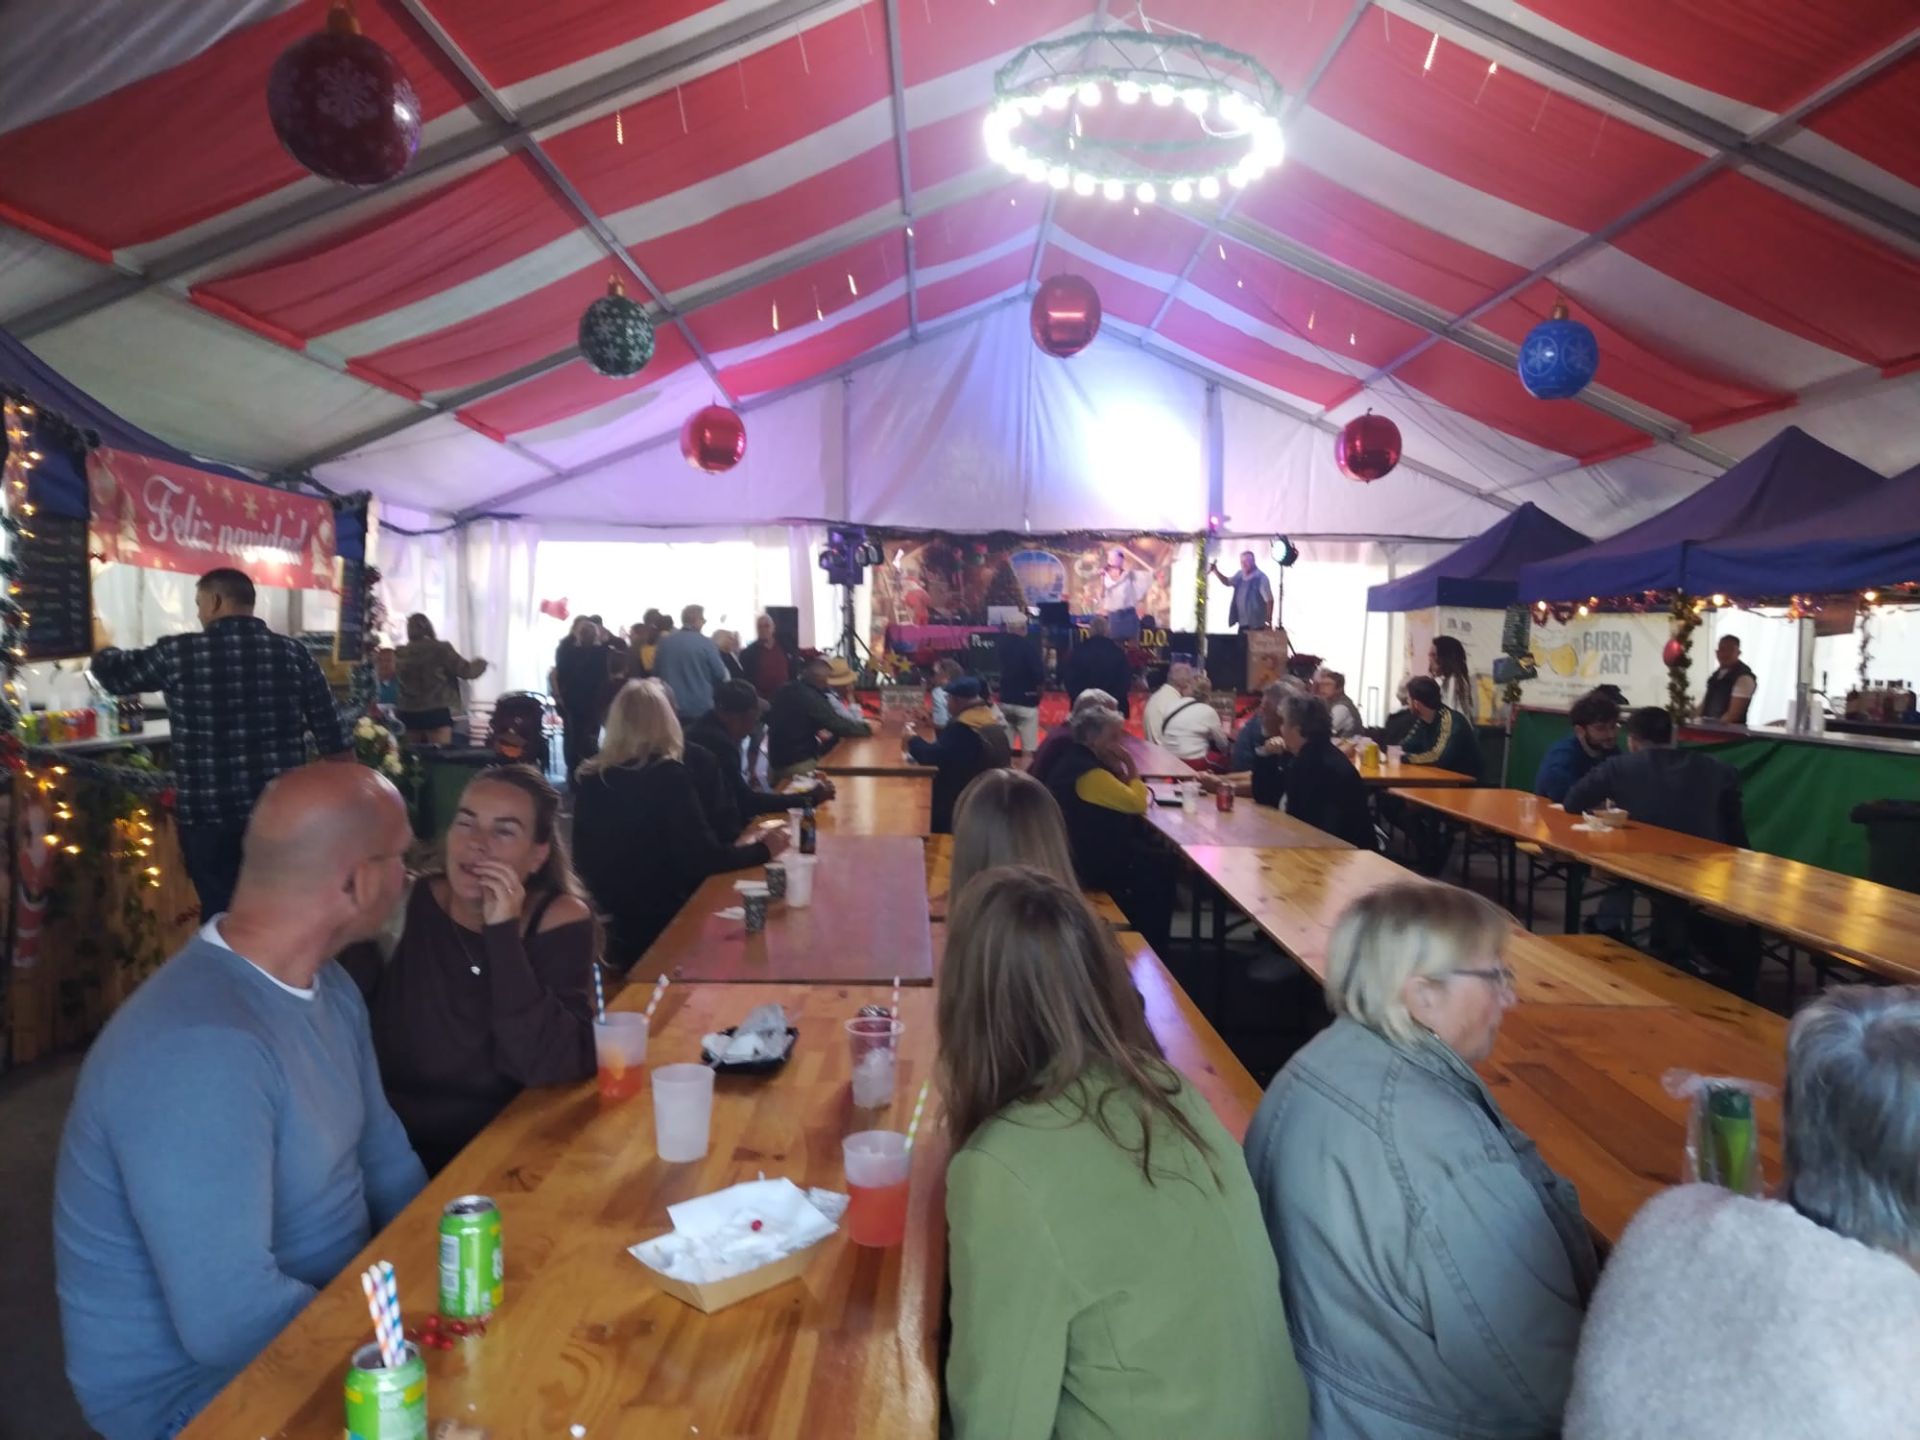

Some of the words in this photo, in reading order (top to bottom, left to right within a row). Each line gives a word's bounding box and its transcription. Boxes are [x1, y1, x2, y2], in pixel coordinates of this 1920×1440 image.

[143, 475, 214, 551] Feliz
[1583, 631, 1632, 653] BIRRA
[1599, 653, 1632, 675] ART
